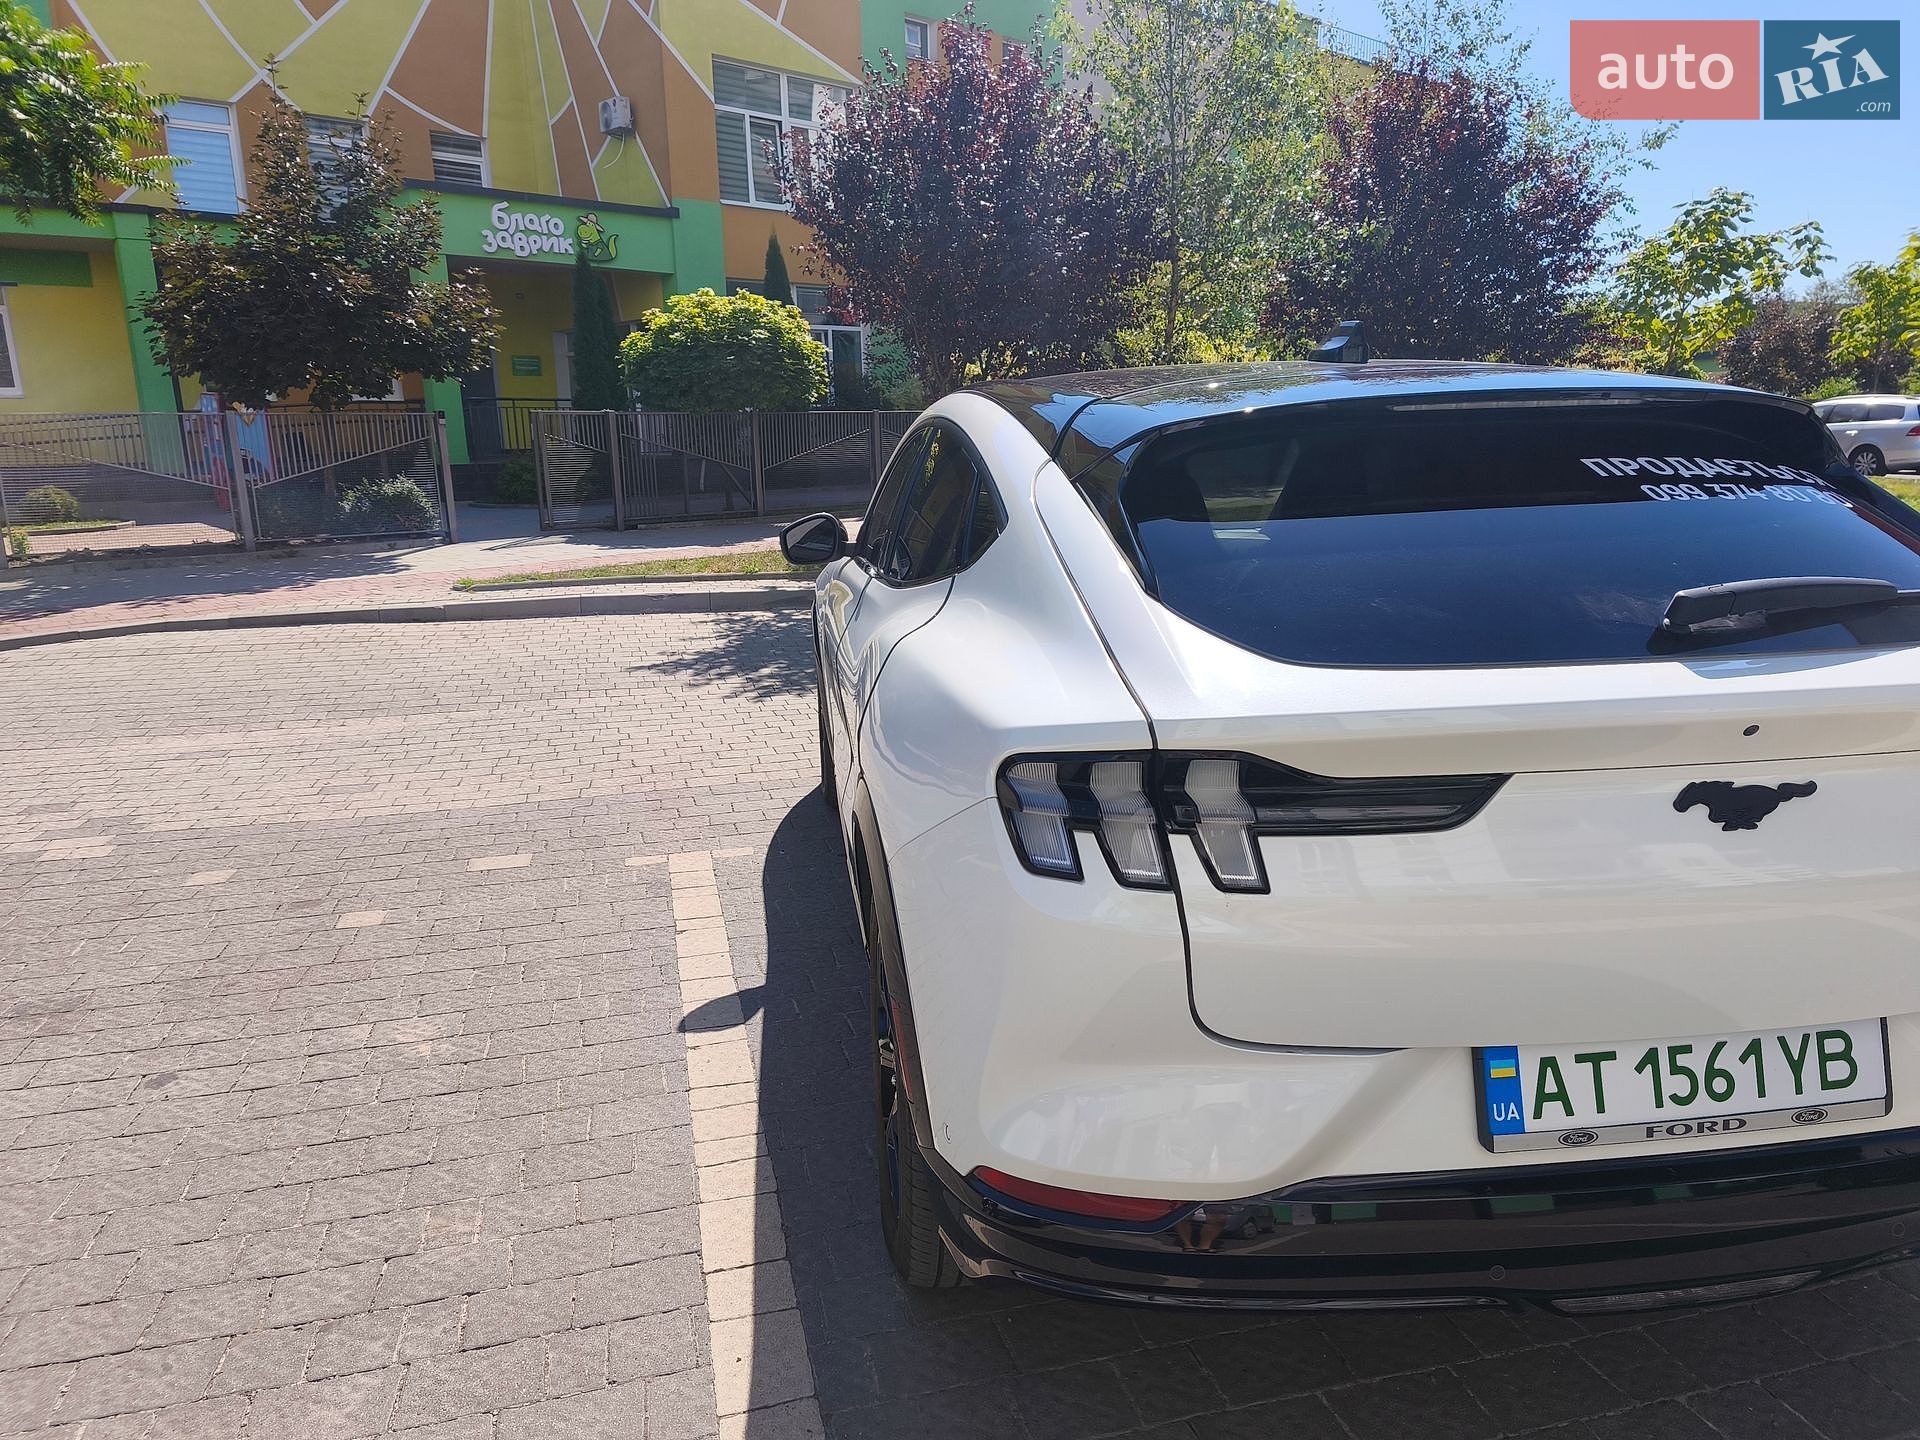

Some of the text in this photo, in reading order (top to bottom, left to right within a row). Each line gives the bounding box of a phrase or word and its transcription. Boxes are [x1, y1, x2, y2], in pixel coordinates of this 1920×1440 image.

[491, 200, 565, 236] благо
[481, 229, 574, 257] заврик
[1580, 457, 1837, 489] ПРОДАЄТЬСЯ
[1640, 484, 1705, 501] 099
[1704, 483, 1768, 500] 374
[1763, 485, 1812, 502] 80
[1532, 1029, 1859, 1120] AT 1561 YB
[1493, 1104, 1521, 1122] UA
[1646, 1118, 1747, 1139] FORD
